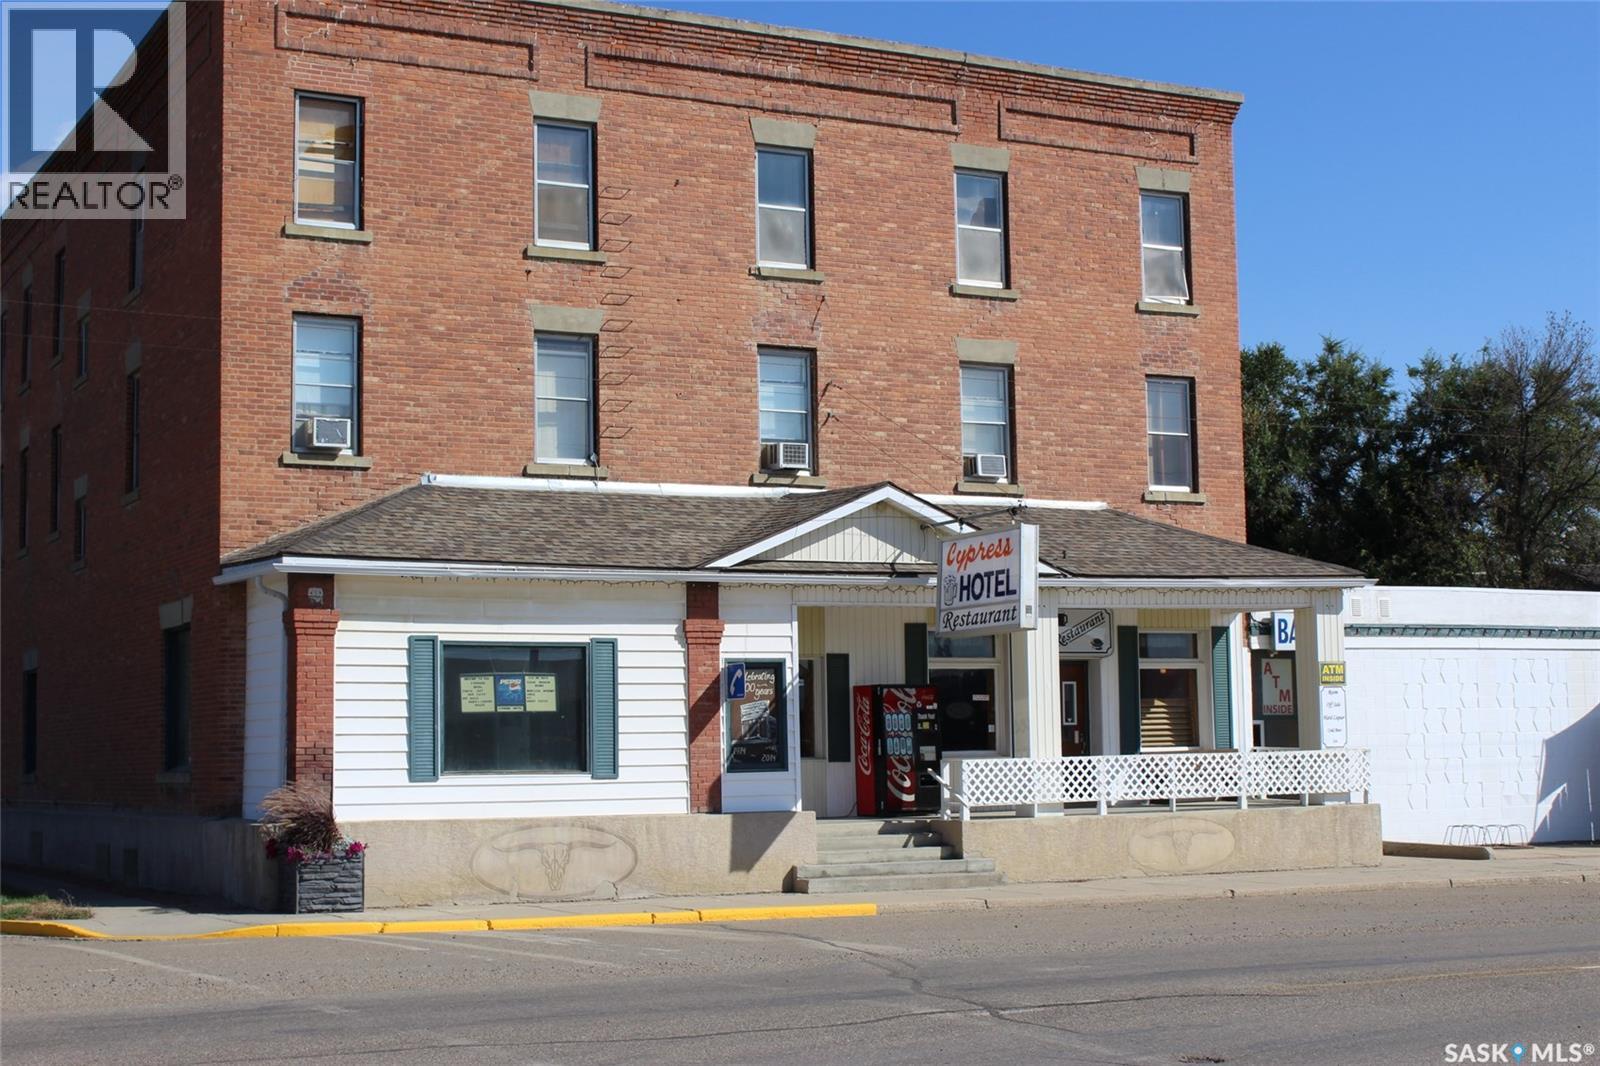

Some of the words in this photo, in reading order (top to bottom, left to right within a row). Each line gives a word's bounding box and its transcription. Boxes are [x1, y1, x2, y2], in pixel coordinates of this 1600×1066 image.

[946, 537, 1014, 572] Cypress
[959, 568, 1017, 602] HOTEL
[943, 605, 1017, 632] Restaurant
[1322, 664, 1344, 674] ATM
[744, 671, 776, 684] lebrating
[1322, 674, 1344, 682] INSIDE
[745, 682, 756, 693] 00
[753, 687, 774, 700] years
[1263, 704, 1293, 714] INSIDE
